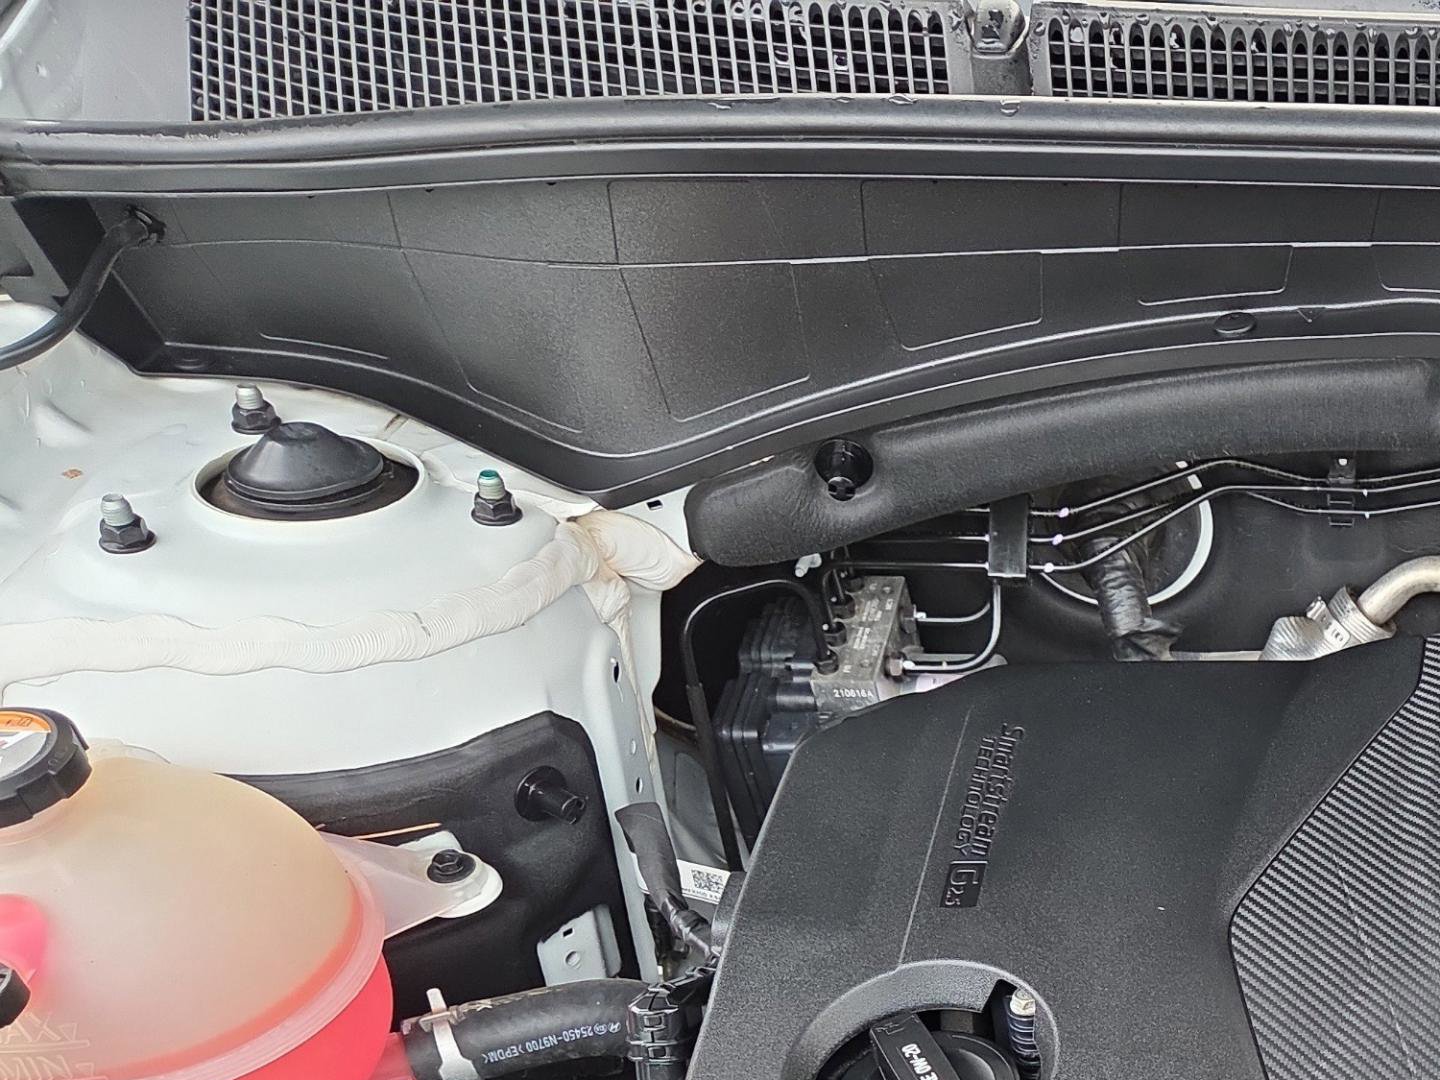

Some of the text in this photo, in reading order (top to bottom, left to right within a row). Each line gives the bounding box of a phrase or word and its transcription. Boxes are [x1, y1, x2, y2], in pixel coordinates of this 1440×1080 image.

[953, 736, 995, 856] TECHNOLOGY
[970, 722, 1025, 855] Smartstream
[525, 1024, 594, 1053] 25450-N9700
[901, 1043, 932, 1075] 0W-20
